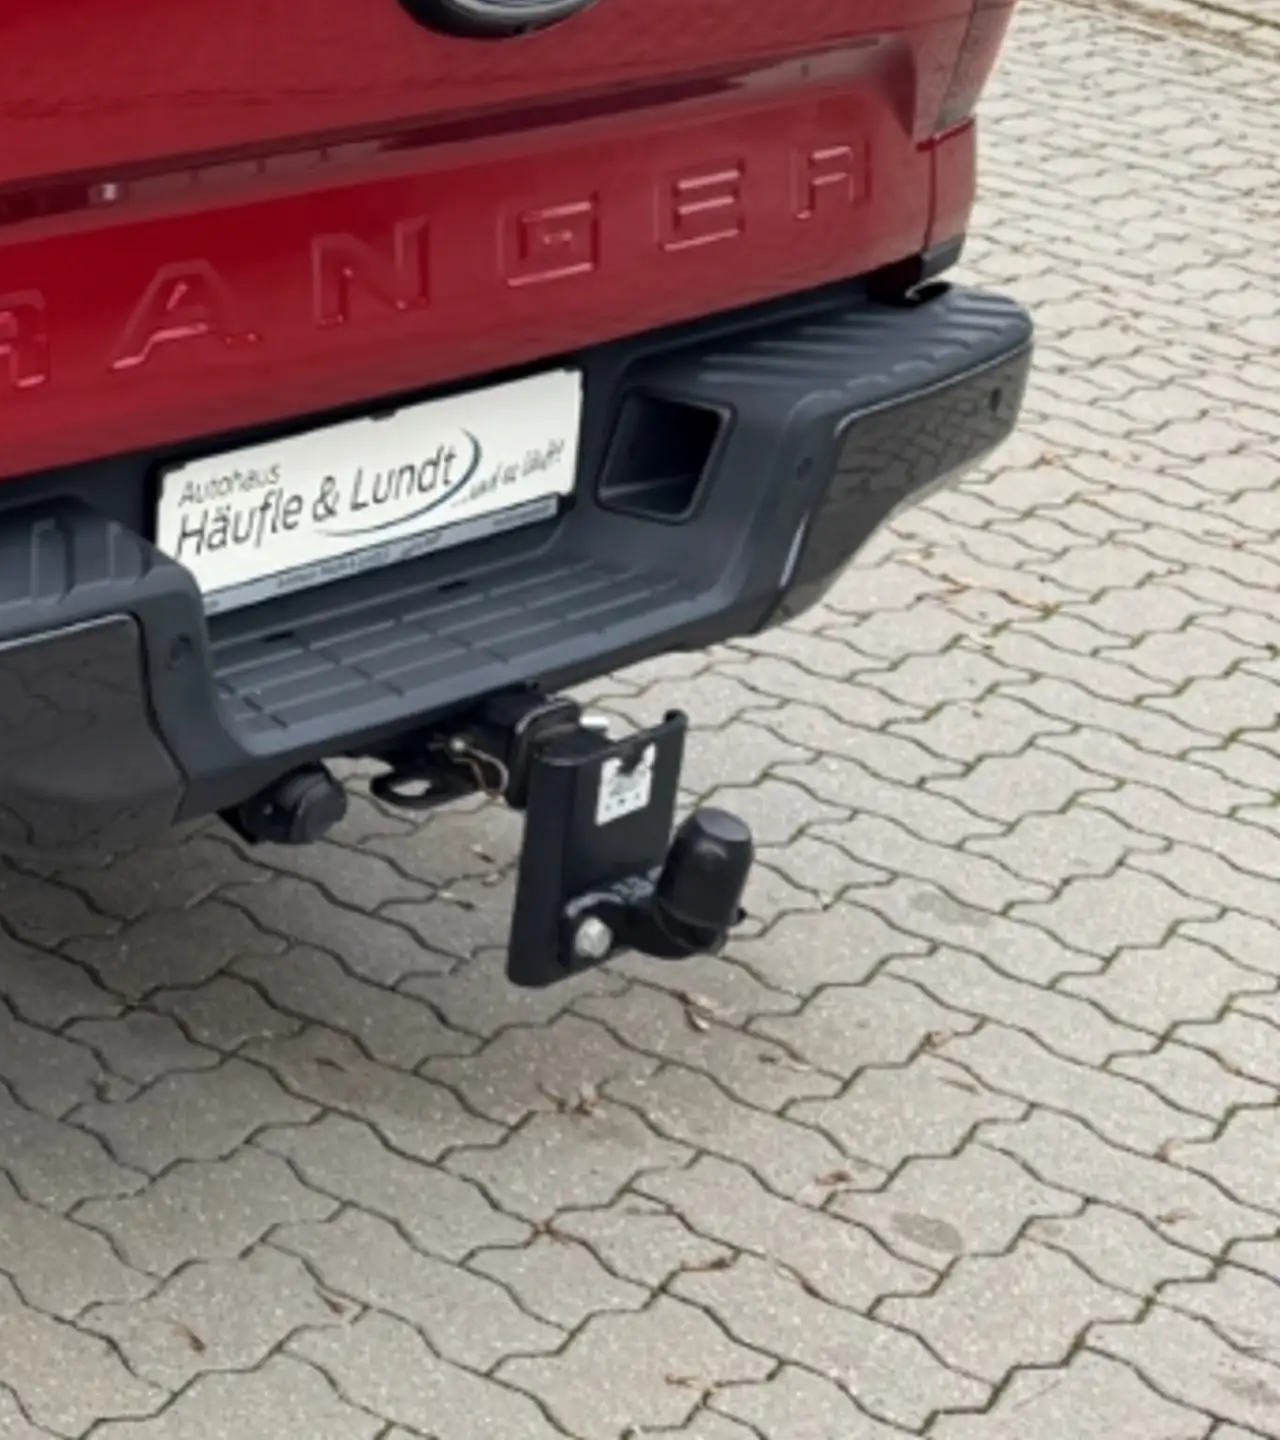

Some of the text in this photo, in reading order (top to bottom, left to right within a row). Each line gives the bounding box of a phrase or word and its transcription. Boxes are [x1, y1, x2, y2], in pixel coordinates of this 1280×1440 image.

[175, 442, 457, 557] Häufle & Lundt
[177, 462, 281, 508] Autohaus
